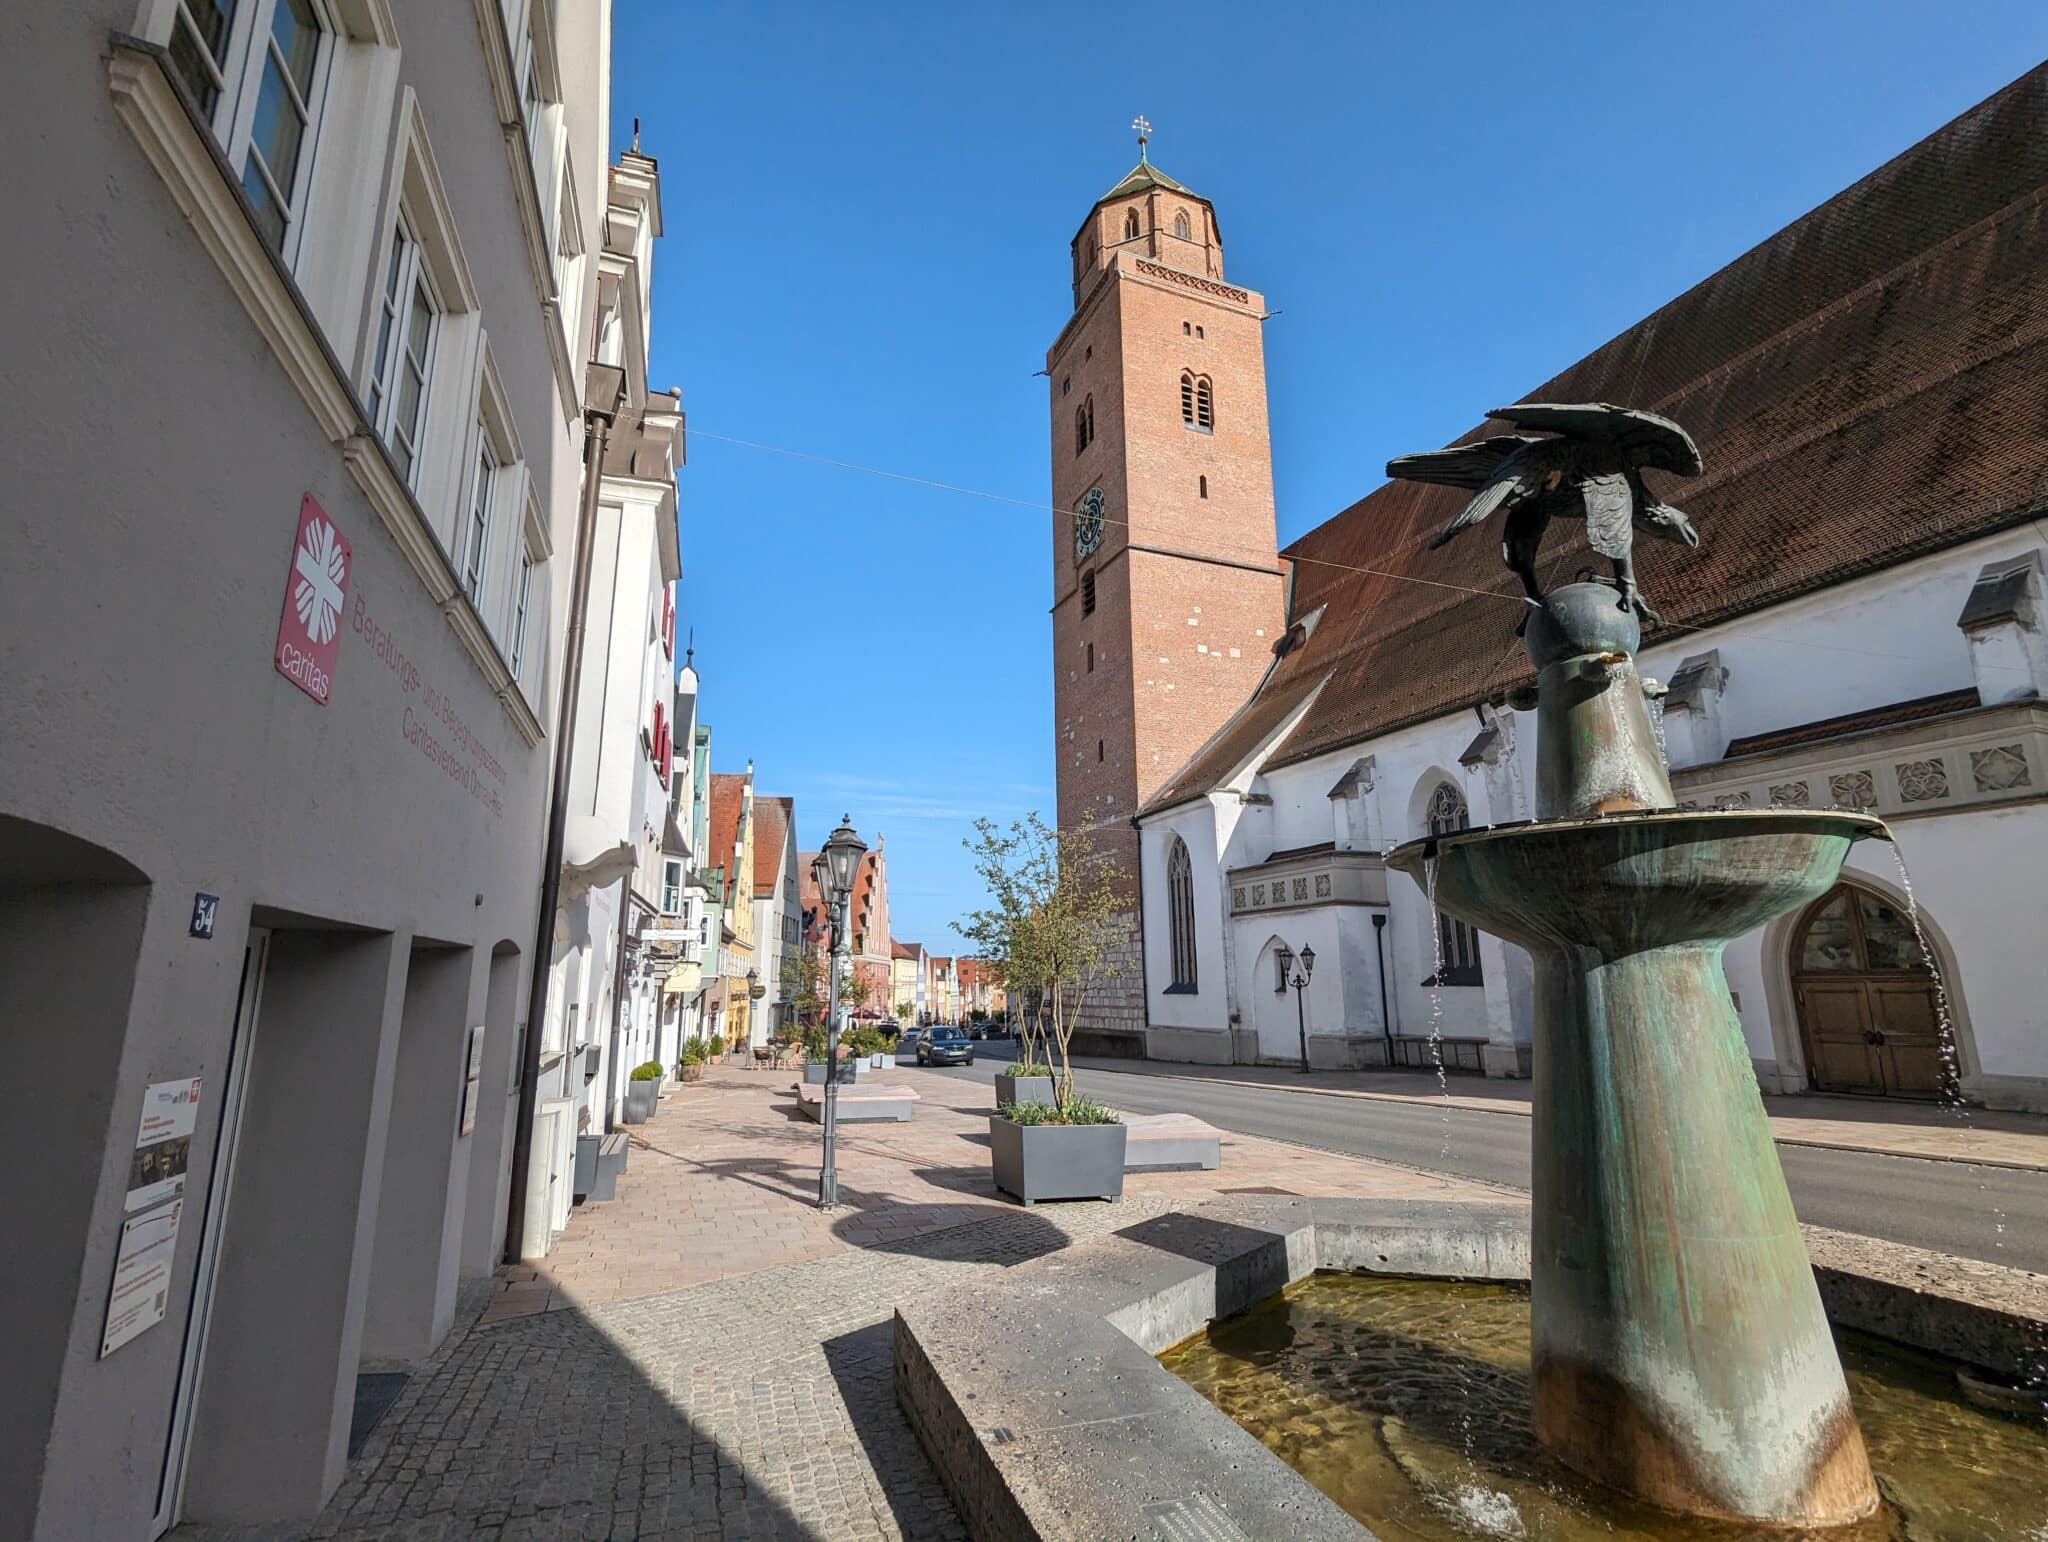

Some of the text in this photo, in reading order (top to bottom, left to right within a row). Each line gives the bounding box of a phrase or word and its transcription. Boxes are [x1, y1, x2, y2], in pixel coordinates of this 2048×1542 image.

[282, 643, 329, 698] caritas
[353, 594, 421, 692] Beratungs-
[441, 696, 507, 785] Begegnungsz
[403, 707, 470, 789] Caritasverband
[195, 899, 217, 933] 54
